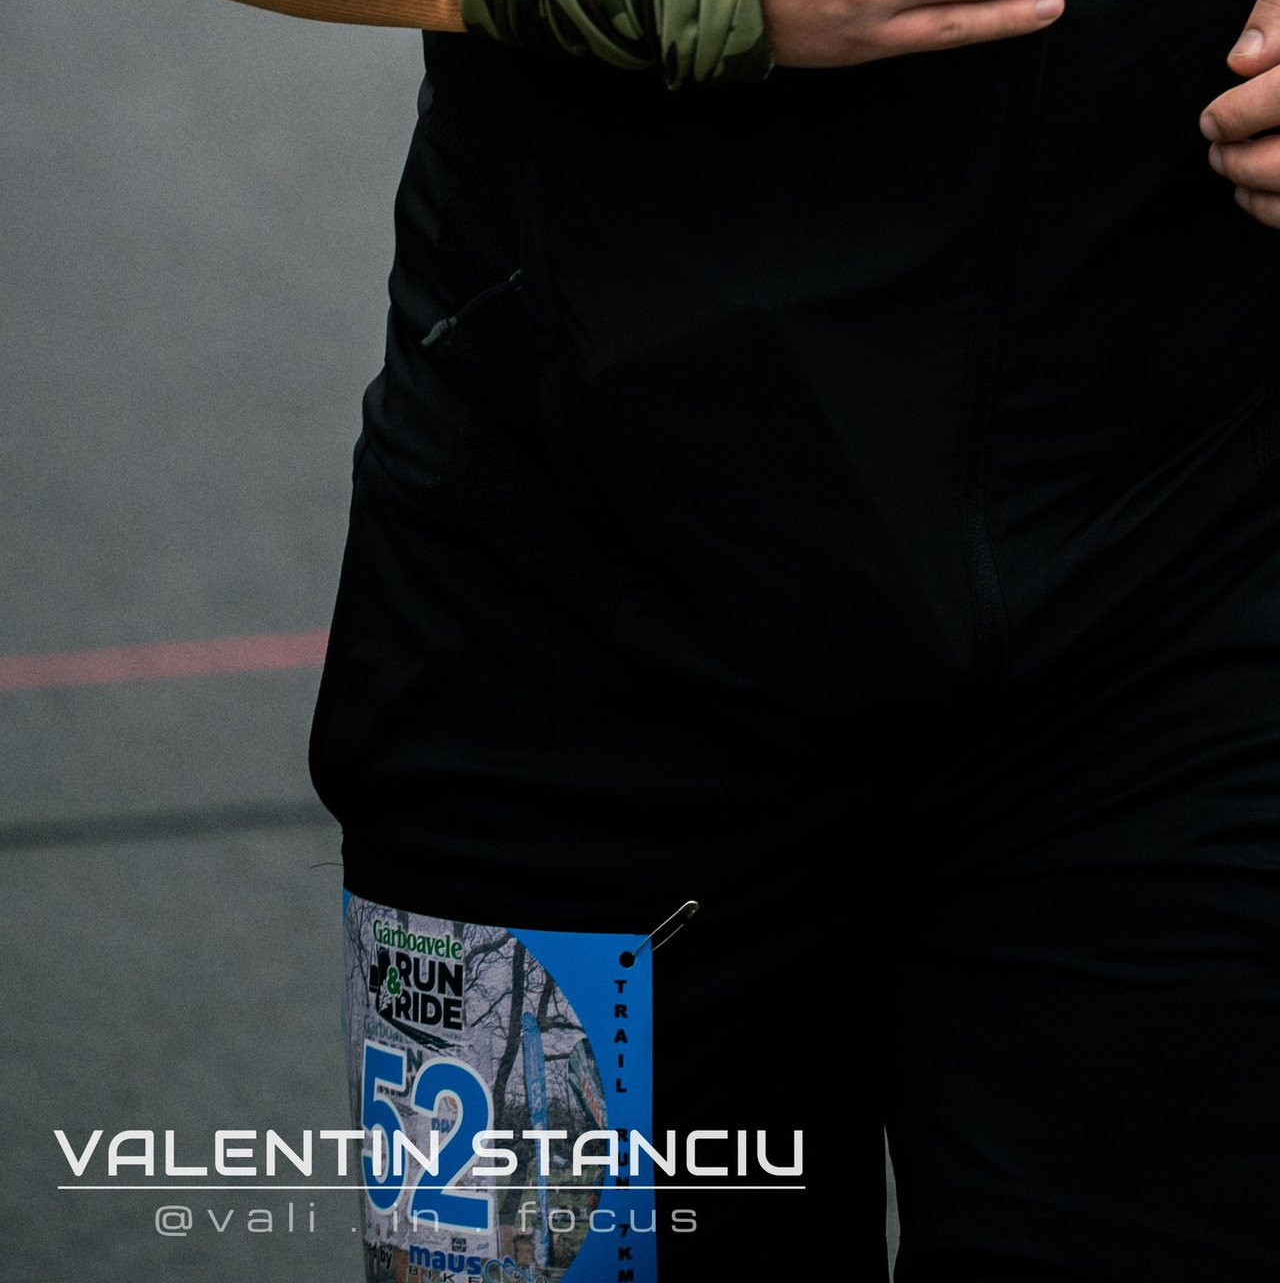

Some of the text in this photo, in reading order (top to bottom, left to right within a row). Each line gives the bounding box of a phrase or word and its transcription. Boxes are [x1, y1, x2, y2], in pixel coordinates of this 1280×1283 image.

[372, 919, 463, 960] Gârboavele
[387, 951, 464, 998] & RUN
[394, 989, 463, 1031] RIDE
[613, 979, 628, 1093] TRAIL
[361, 1039, 494, 1234] 52
[615, 1128, 630, 1191] RUN
[408, 1244, 482, 1276] maus
